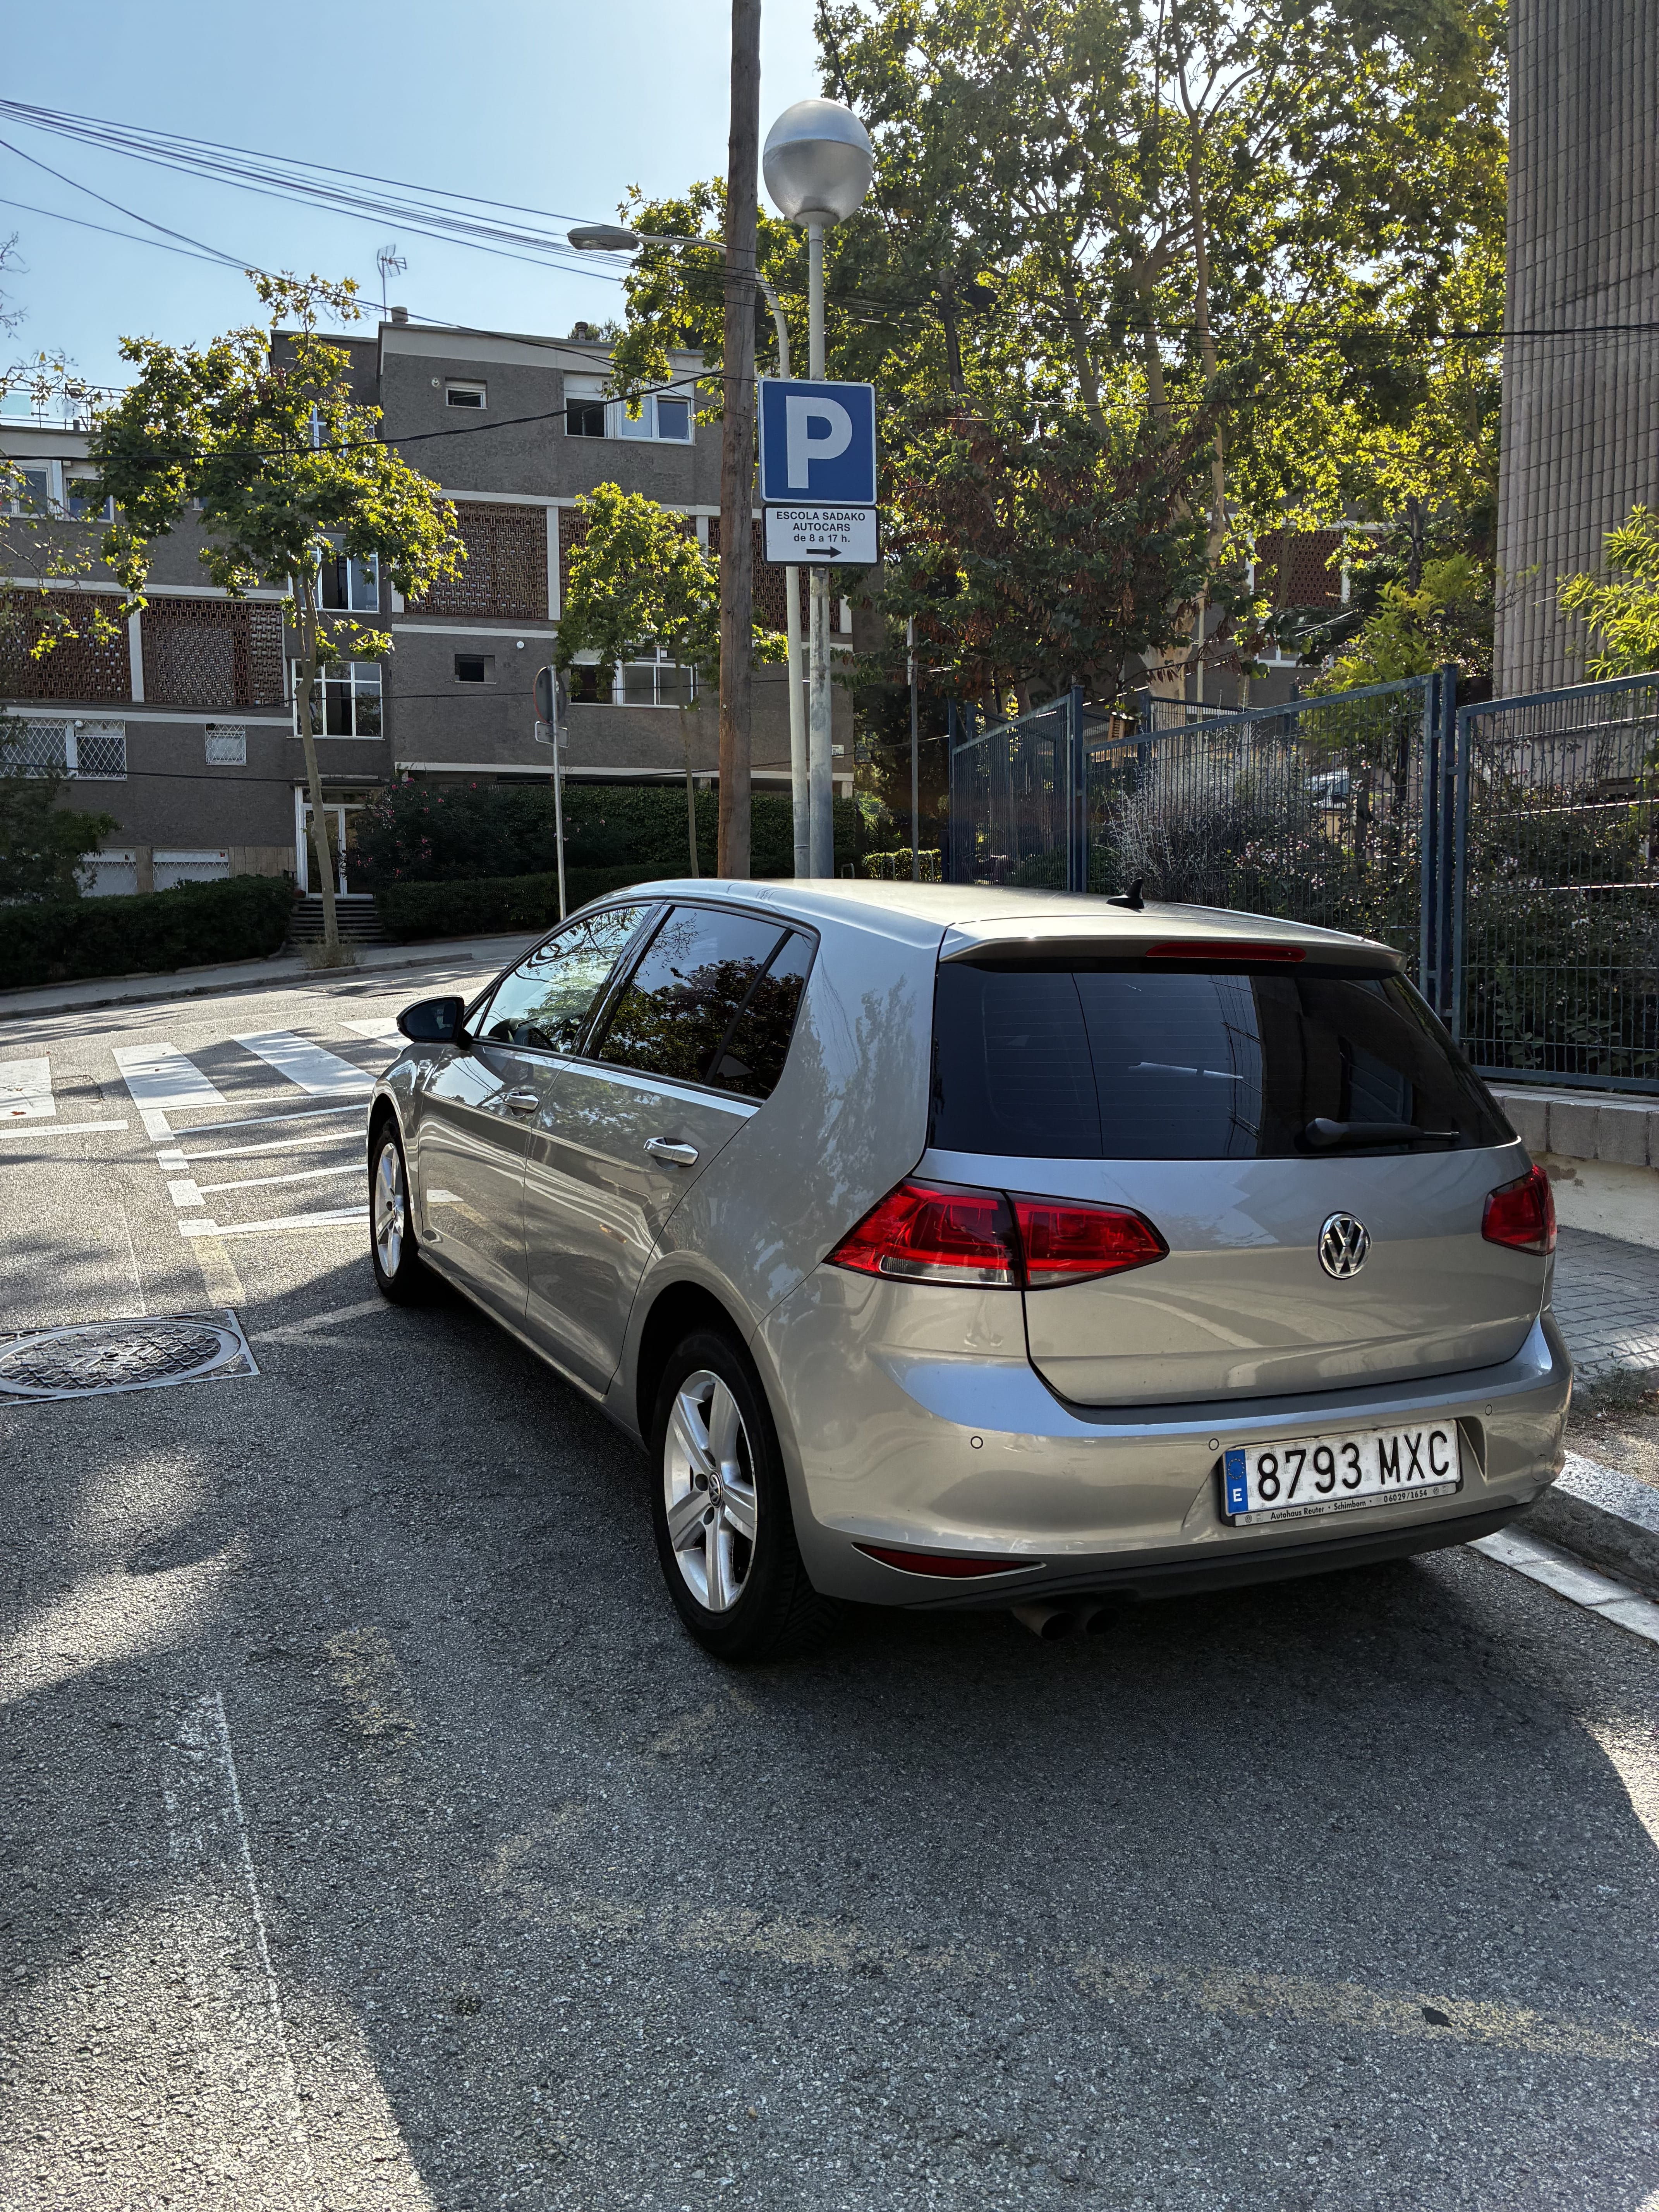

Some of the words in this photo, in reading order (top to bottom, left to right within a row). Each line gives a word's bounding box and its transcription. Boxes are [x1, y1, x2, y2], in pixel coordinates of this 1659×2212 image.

[786, 395, 853, 489] P
[776, 511, 819, 520] ESCOLA
[823, 512, 865, 521] SADAKO
[793, 523, 850, 532] AUTOCARS
[794, 534, 806, 542] de
[809, 534, 815, 542] 8
[828, 534, 838, 543] 17
[1257, 1442, 1362, 1501] 8793
[1378, 1430, 1449, 1485] MXC
[1233, 1488, 1242, 1502] E
[1271, 1509, 1302, 1520] Autohaus
[1304, 1506, 1324, 1516] Reuter
[1384, 1489, 1427, 1503] 06029/1654
